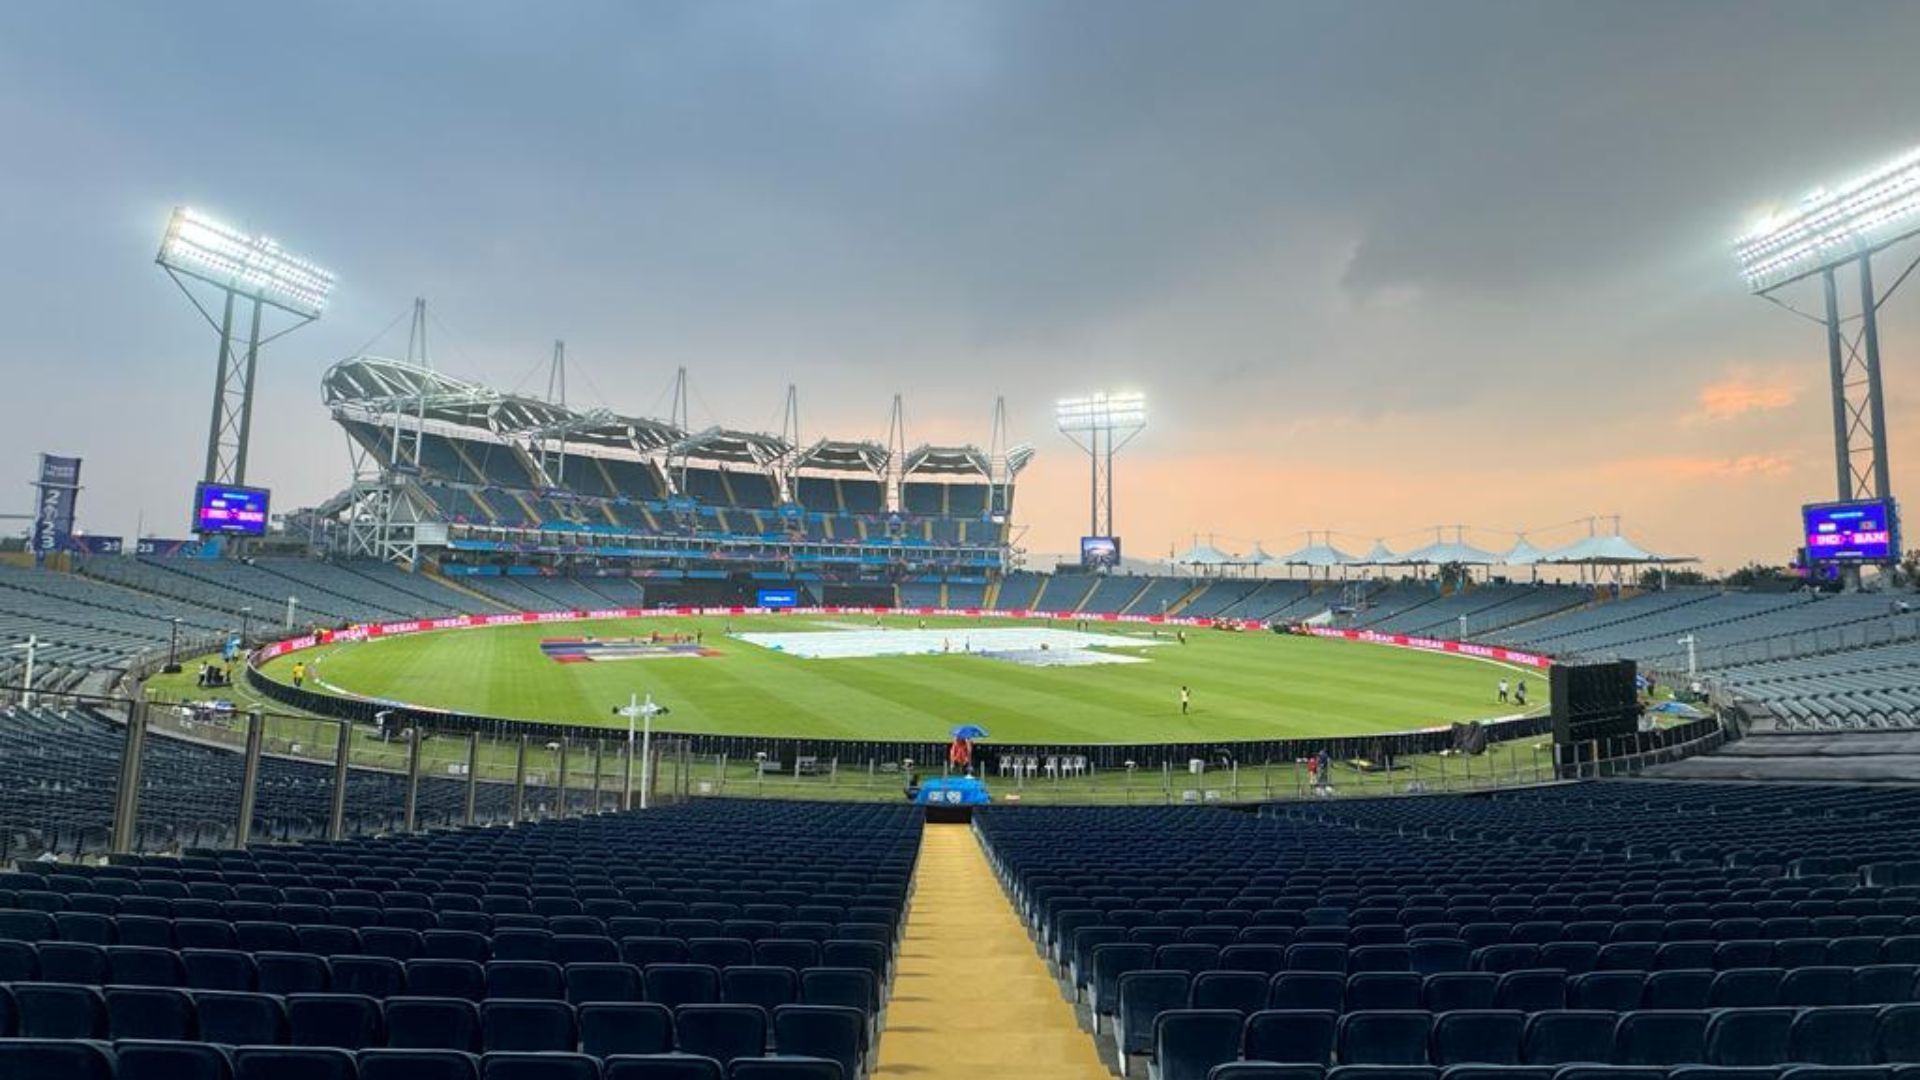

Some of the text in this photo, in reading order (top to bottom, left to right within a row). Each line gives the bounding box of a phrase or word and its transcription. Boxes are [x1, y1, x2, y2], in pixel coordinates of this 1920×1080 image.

[1853, 532, 1888, 545] BAN
[382, 622, 419, 634] NISSAN
[1408, 637, 1444, 649] NISSAN
[1458, 644, 1493, 657] NISSAN
[1506, 651, 1539, 666] NISSAN
